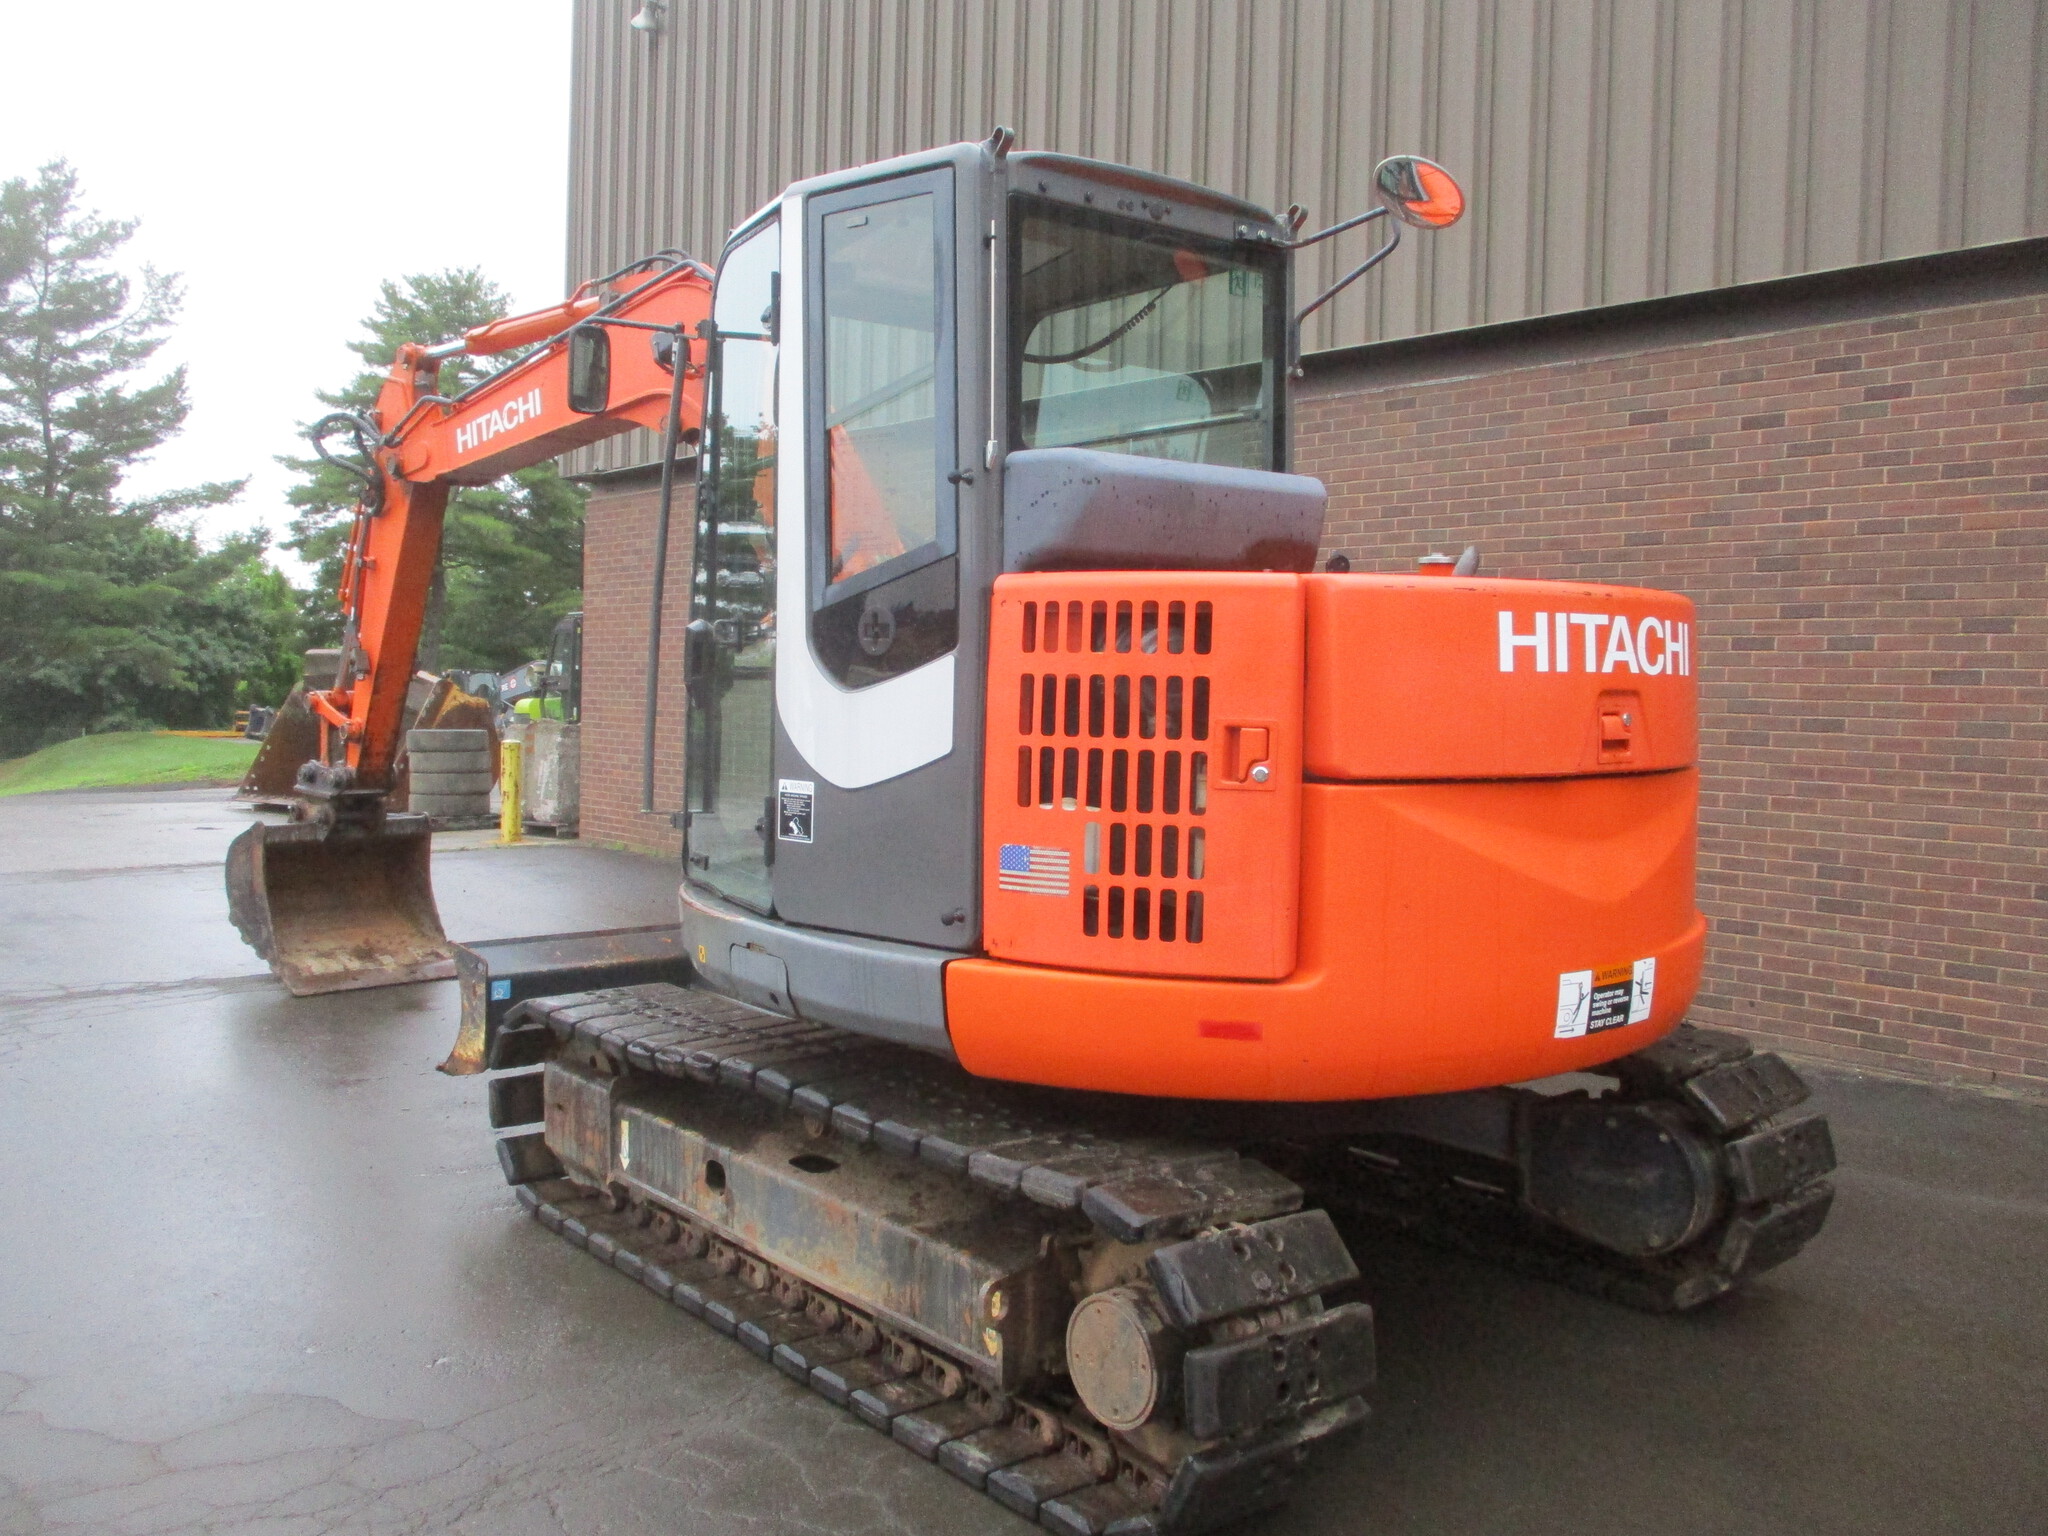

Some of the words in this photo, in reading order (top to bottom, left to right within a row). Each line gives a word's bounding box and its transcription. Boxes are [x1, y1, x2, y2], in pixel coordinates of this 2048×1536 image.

[456, 388, 542, 454] HITACHI
[1498, 611, 1689, 676] HITACHI
[1602, 965, 1633, 980] WARNING
[1592, 1000, 1607, 1009] swing
[1613, 996, 1630, 1004] reverse
[1593, 990, 1614, 1000] Operator
[1591, 1007, 1612, 1016] machine
[1589, 1017, 1606, 1029] STAY
[1605, 1014, 1625, 1026] CLEAR
